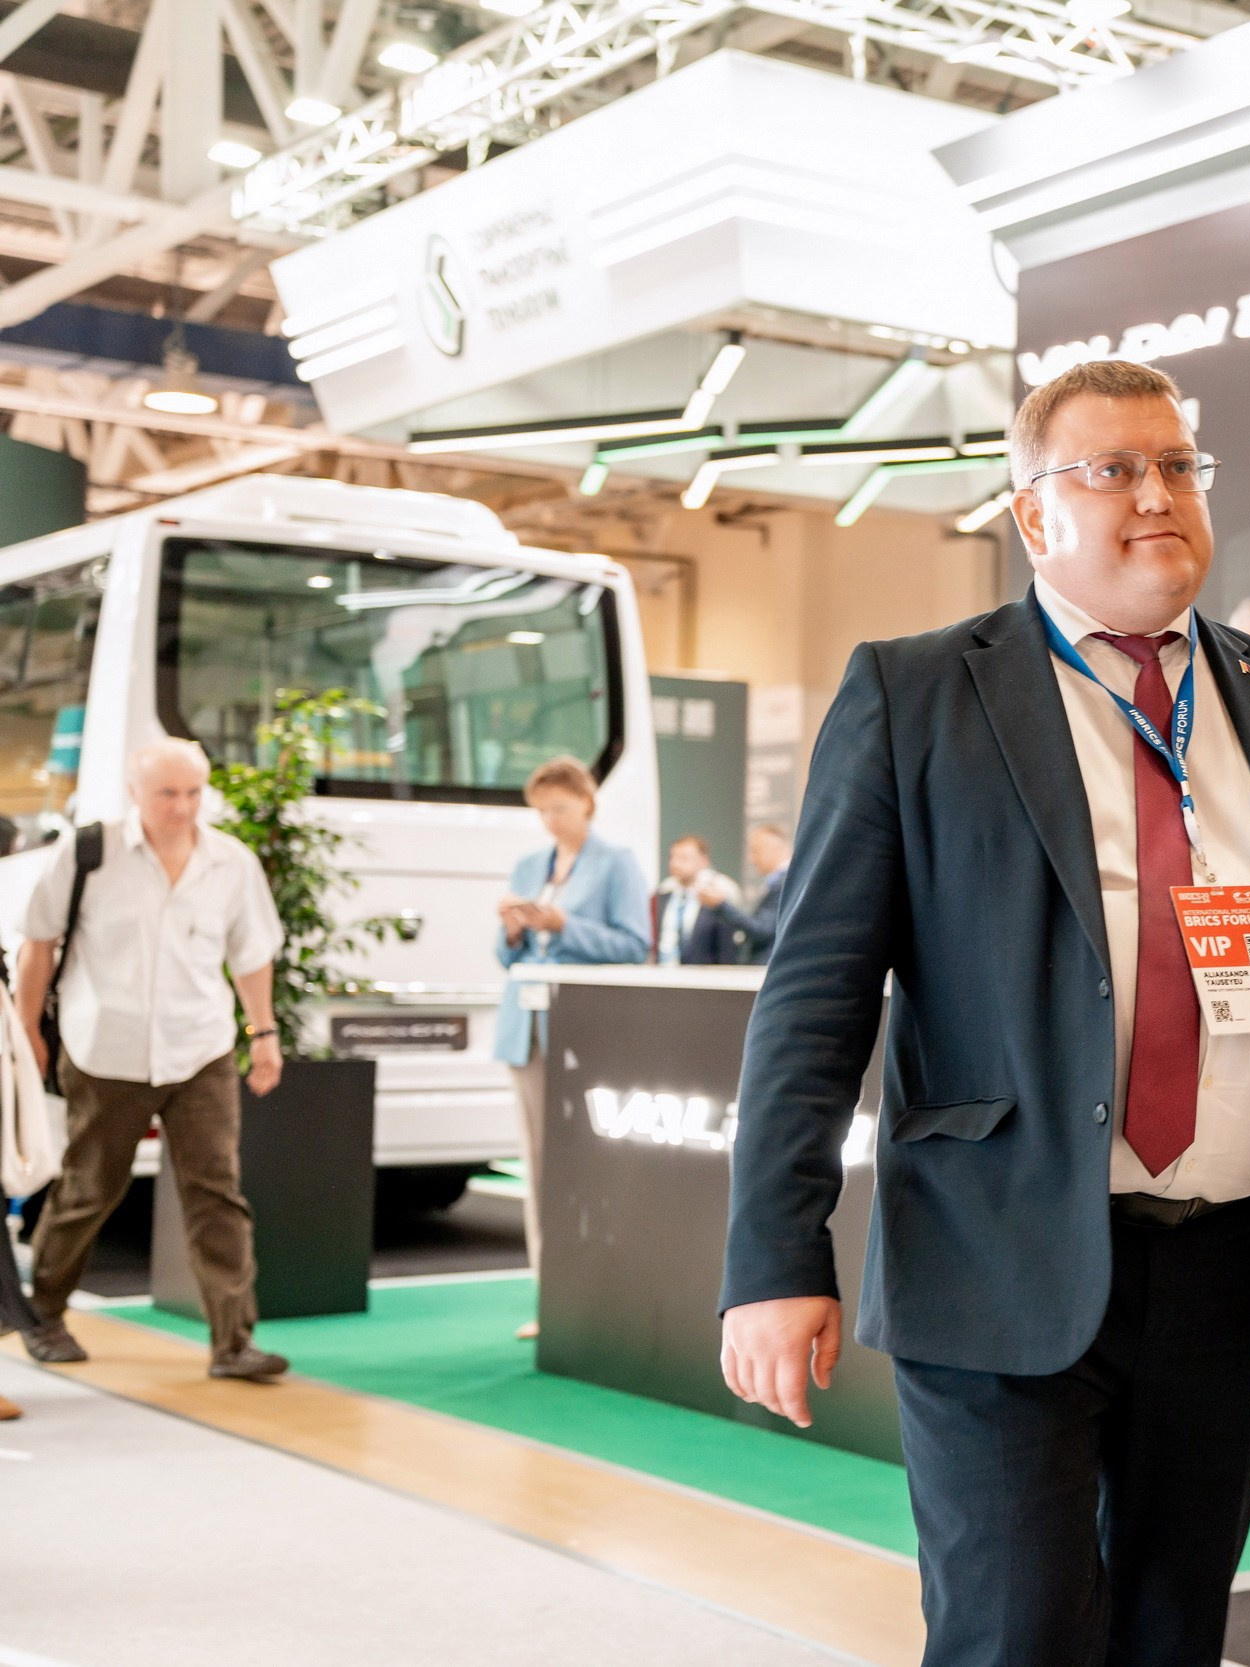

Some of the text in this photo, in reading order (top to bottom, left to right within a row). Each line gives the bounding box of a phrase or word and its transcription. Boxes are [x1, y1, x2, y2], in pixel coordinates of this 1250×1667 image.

[1128, 709, 1162, 745] IMBRICS
[1177, 699, 1188, 735] FORUM
[1184, 915, 1221, 927] BRICS
[1189, 936, 1232, 957] VIP
